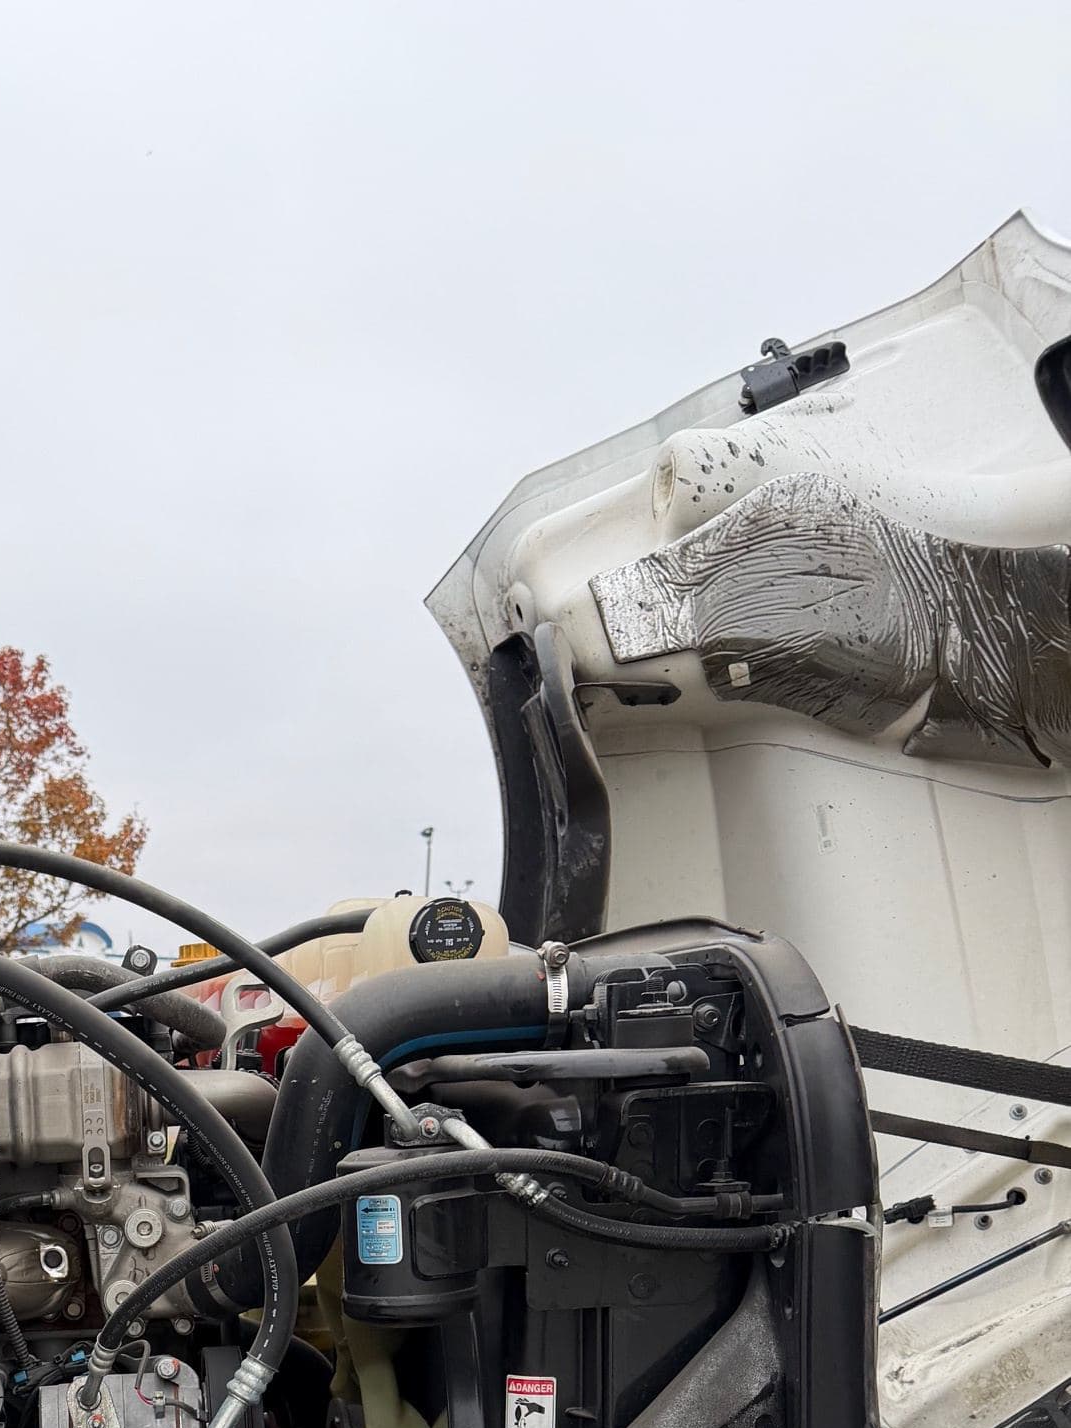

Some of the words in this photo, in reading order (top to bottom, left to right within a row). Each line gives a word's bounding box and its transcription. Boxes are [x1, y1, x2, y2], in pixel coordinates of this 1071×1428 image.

[32, 1003, 64, 1023] GALAXY
[268, 1257, 279, 1290] GALAXY
[516, 1383, 553, 1393] DANGER
